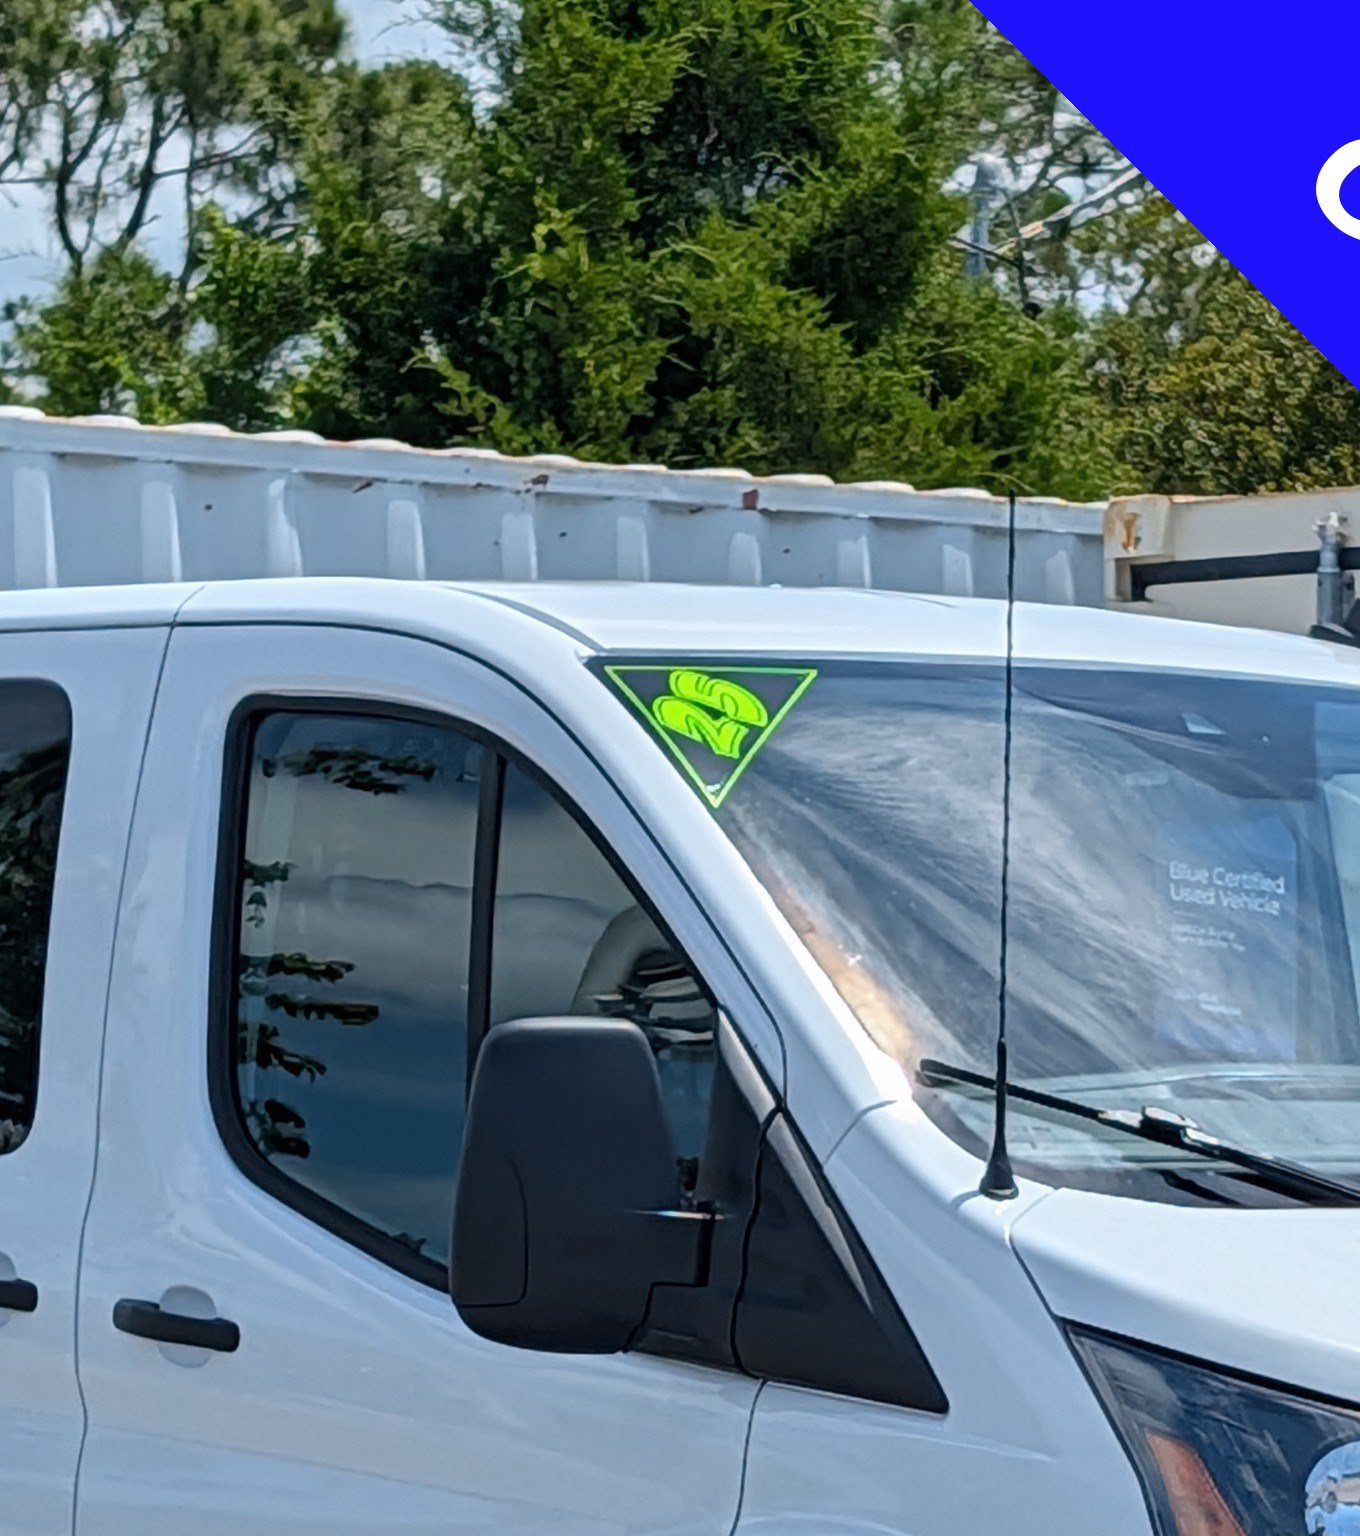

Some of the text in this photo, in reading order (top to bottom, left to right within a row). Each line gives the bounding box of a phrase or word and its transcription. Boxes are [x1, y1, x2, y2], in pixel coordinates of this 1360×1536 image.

[1212, 867, 1285, 894] Certified
[1169, 882, 1280, 916] Used Vehicle
